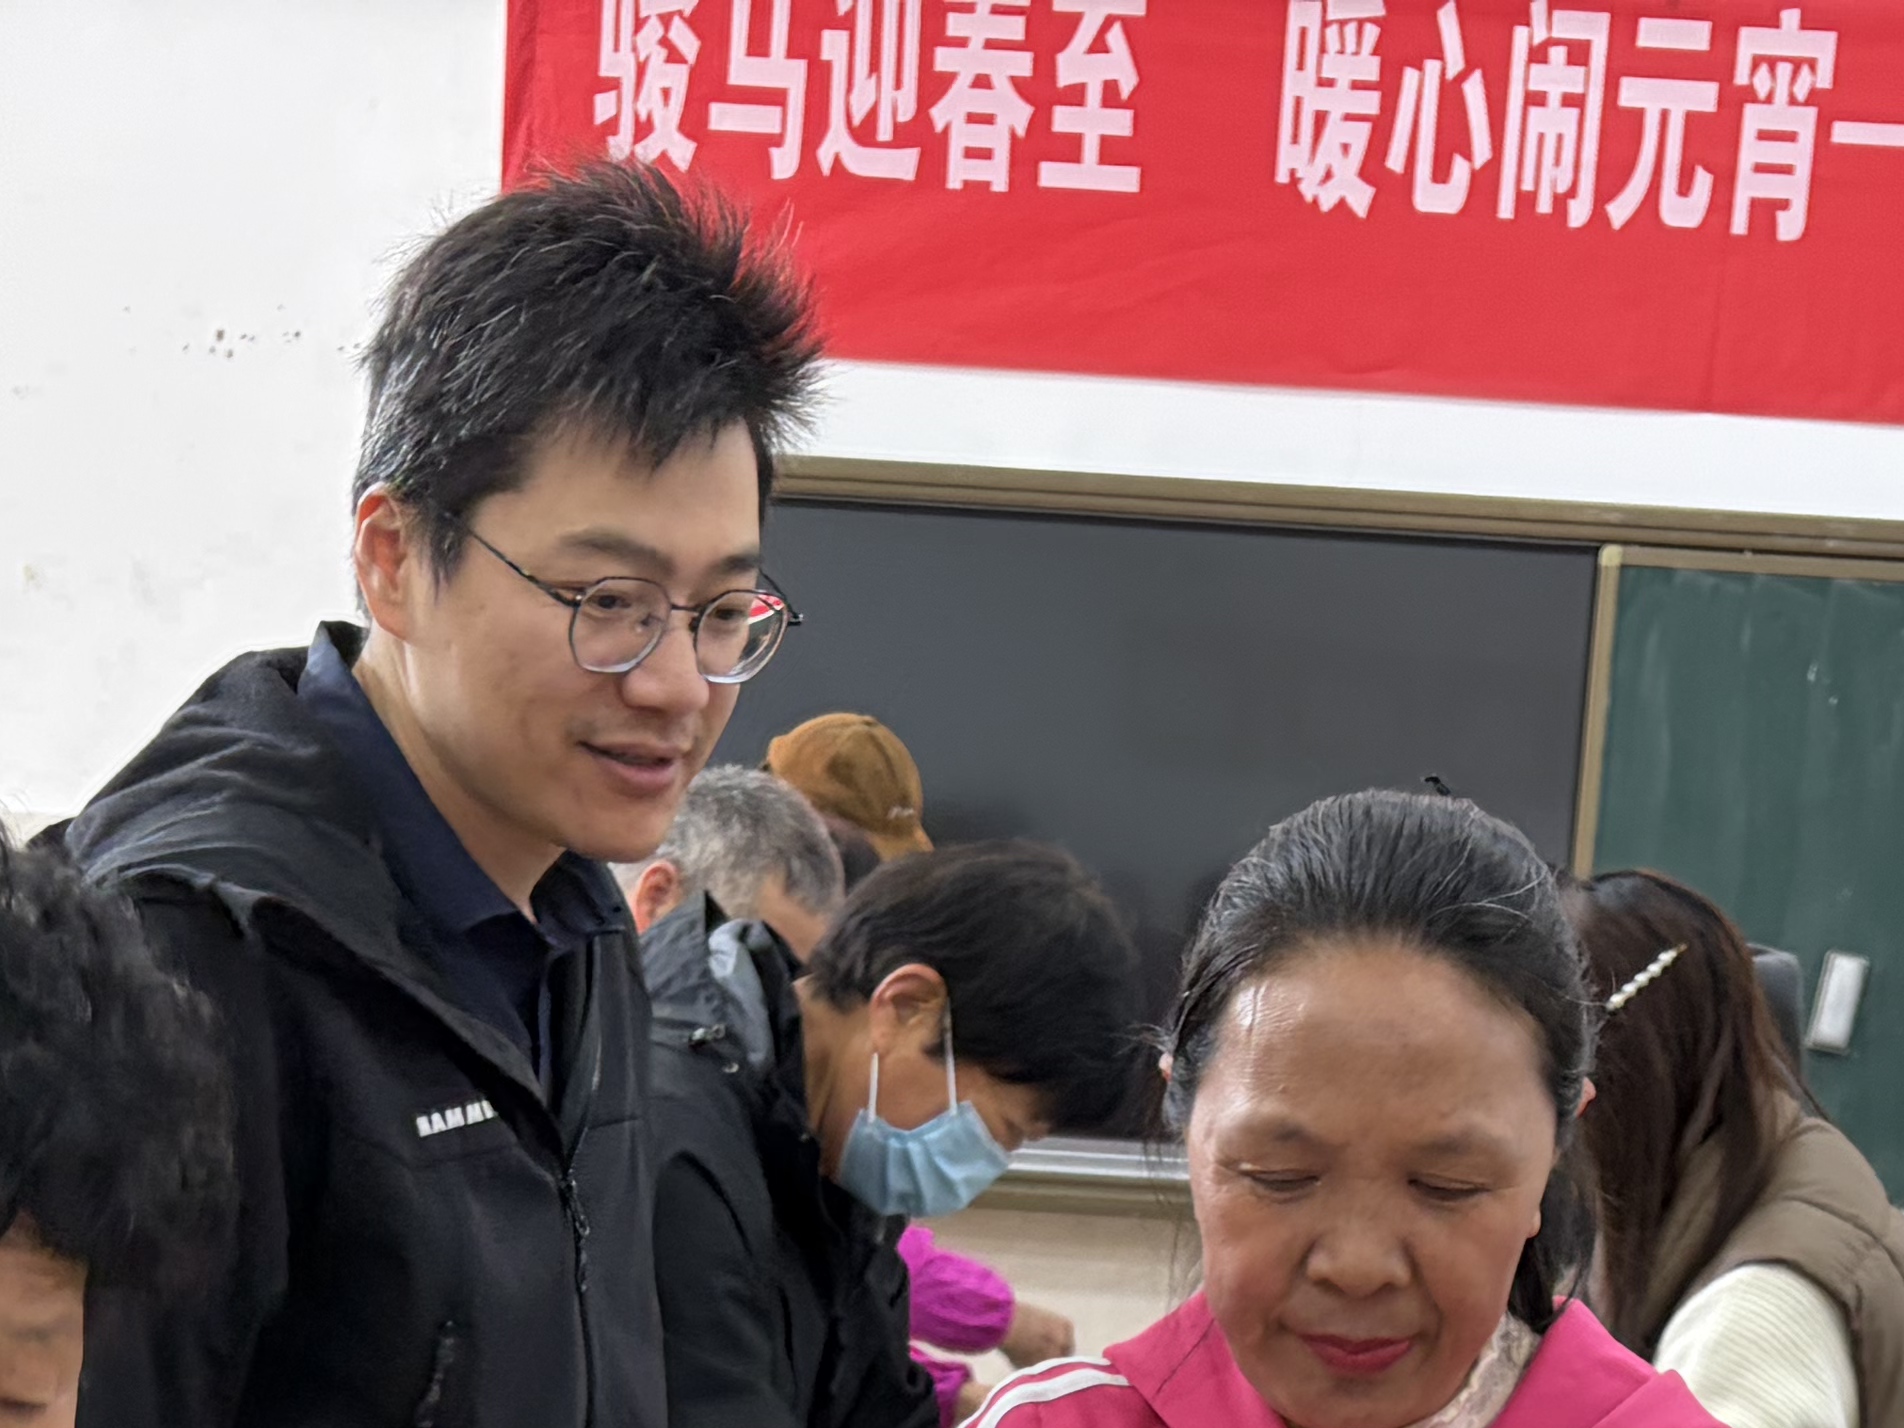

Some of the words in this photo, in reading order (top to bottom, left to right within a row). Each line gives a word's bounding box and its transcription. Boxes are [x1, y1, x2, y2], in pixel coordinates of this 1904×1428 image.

[593, 0, 1146, 192] 骏马迎春至
